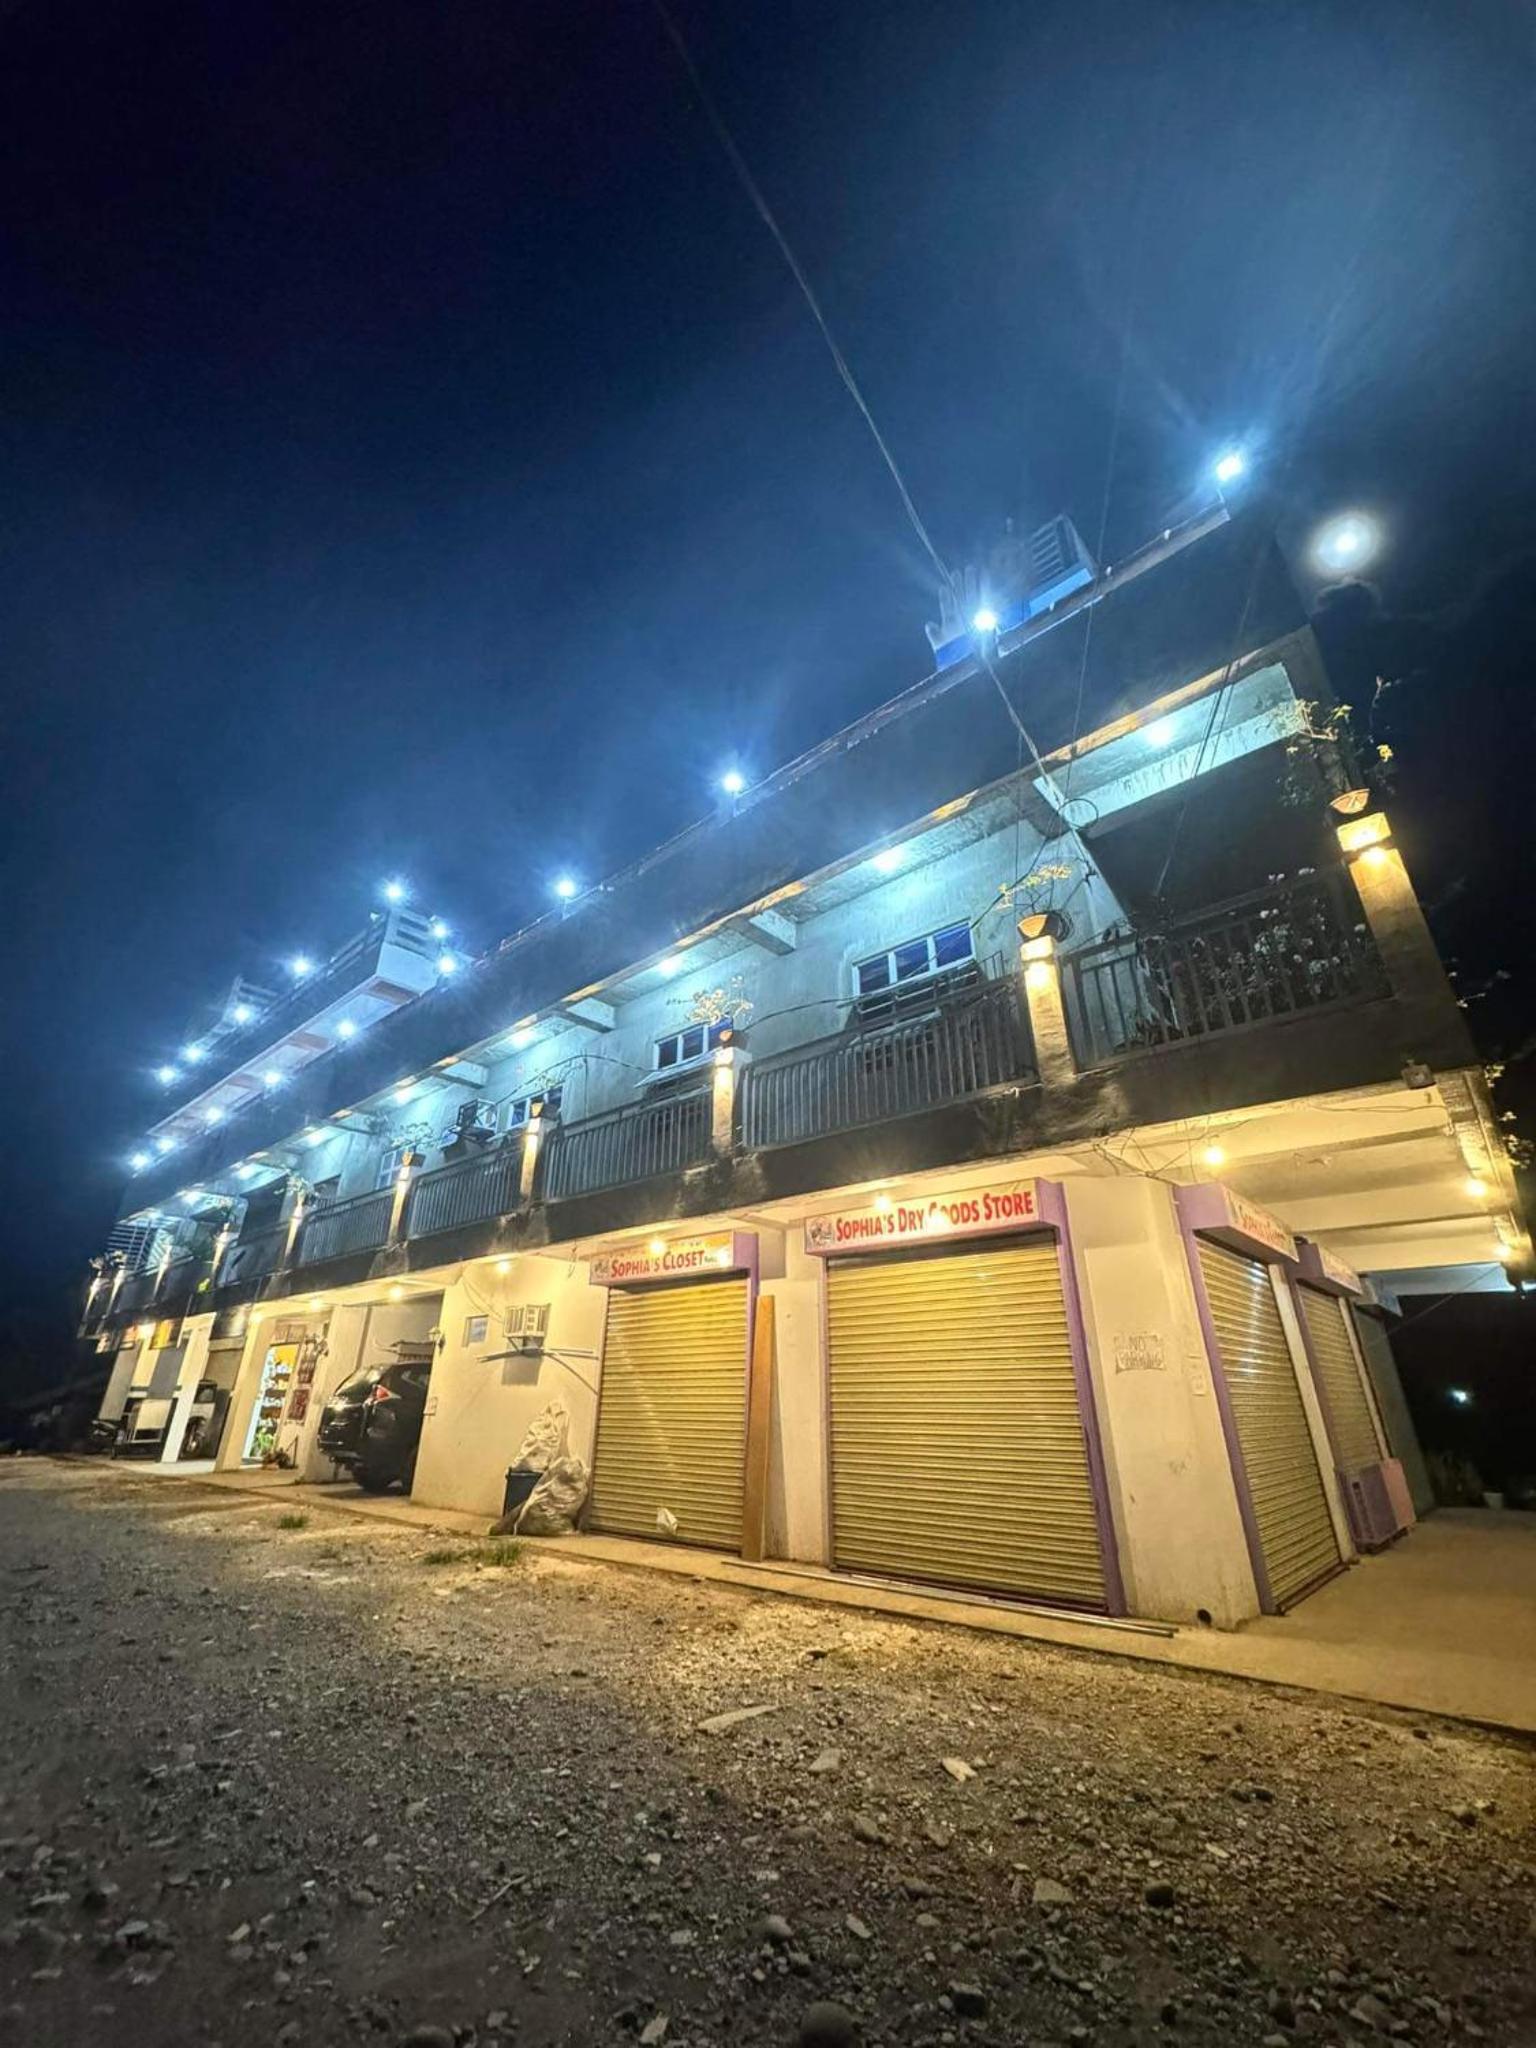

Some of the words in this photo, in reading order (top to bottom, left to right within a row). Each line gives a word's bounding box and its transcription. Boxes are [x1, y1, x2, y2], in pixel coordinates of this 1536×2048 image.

[898, 1207, 924, 1232] DRY
[983, 1191, 1033, 1221] STORE
[662, 1250, 705, 1271] CLOSET
